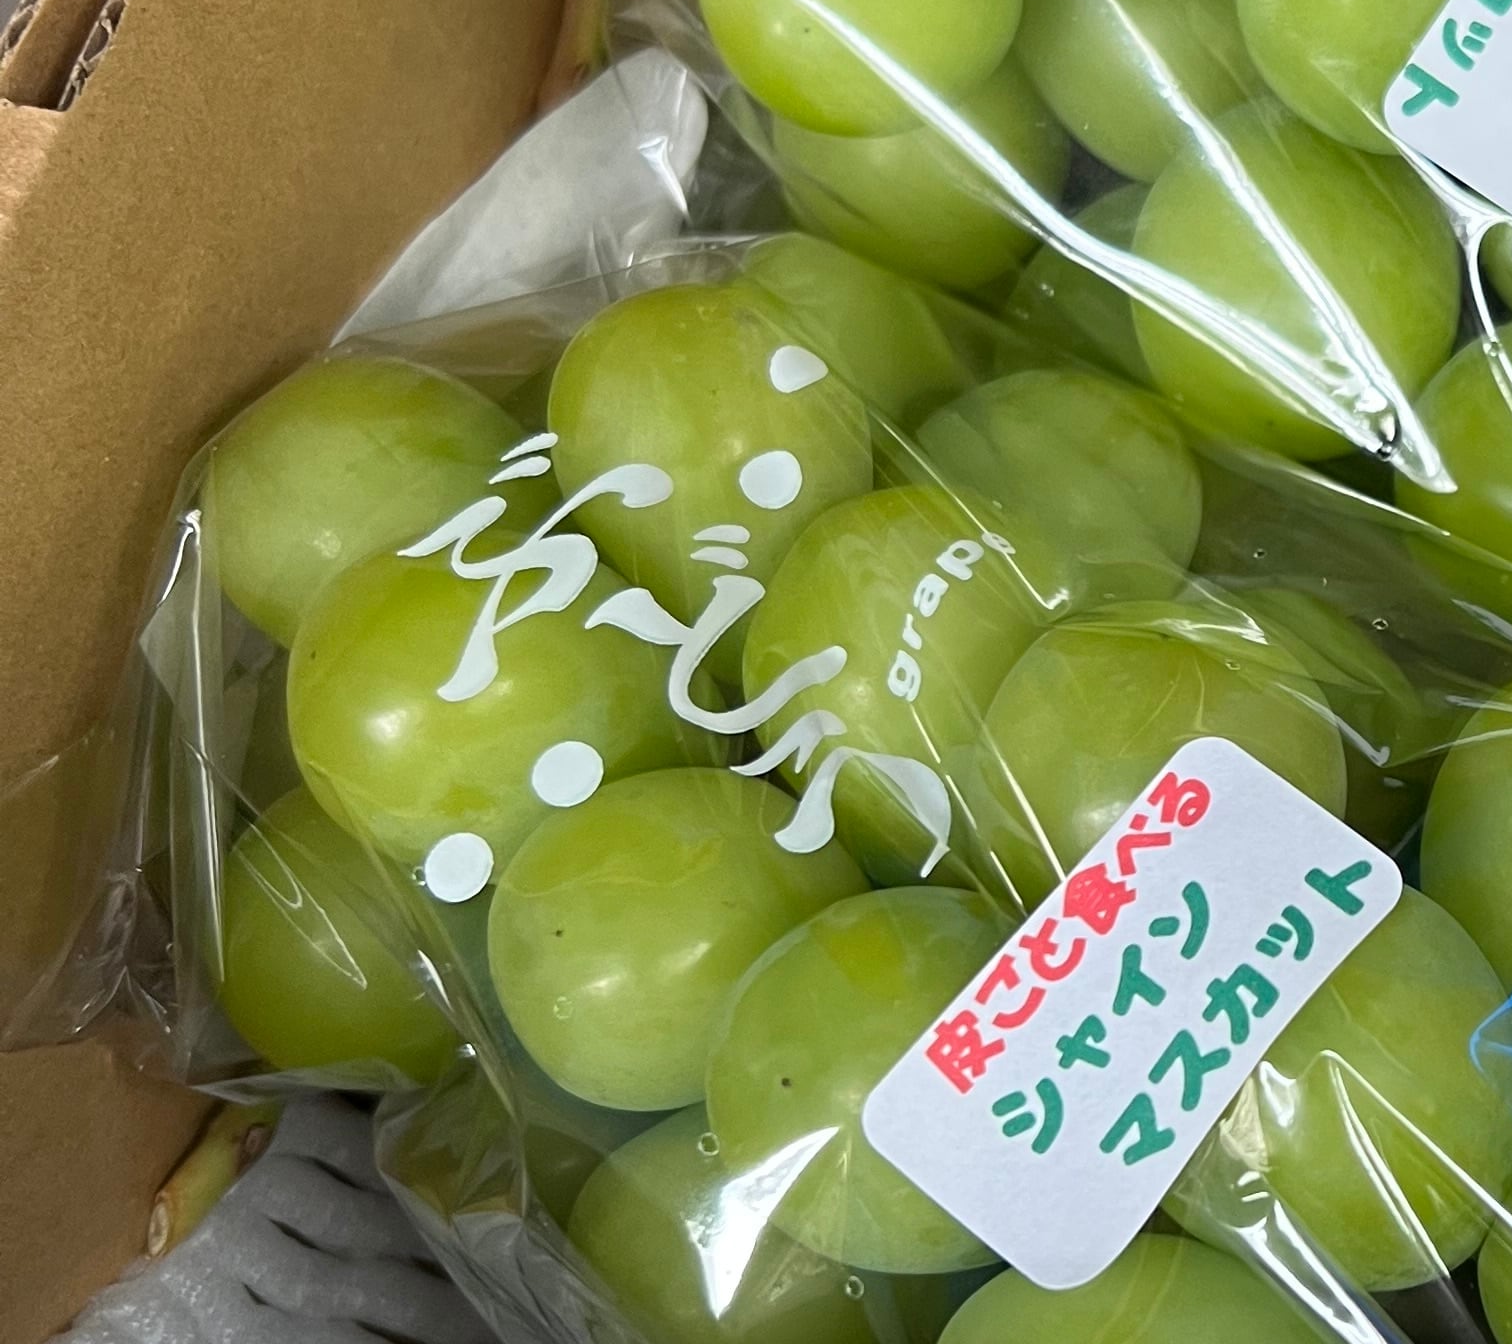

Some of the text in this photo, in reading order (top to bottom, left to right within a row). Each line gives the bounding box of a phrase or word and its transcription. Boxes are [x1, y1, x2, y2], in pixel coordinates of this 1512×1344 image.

[925, 771, 1211, 1094] 皮ごと食べる
[992, 881, 1210, 1154] シャイン
[1099, 860, 1372, 1166] マスカット
